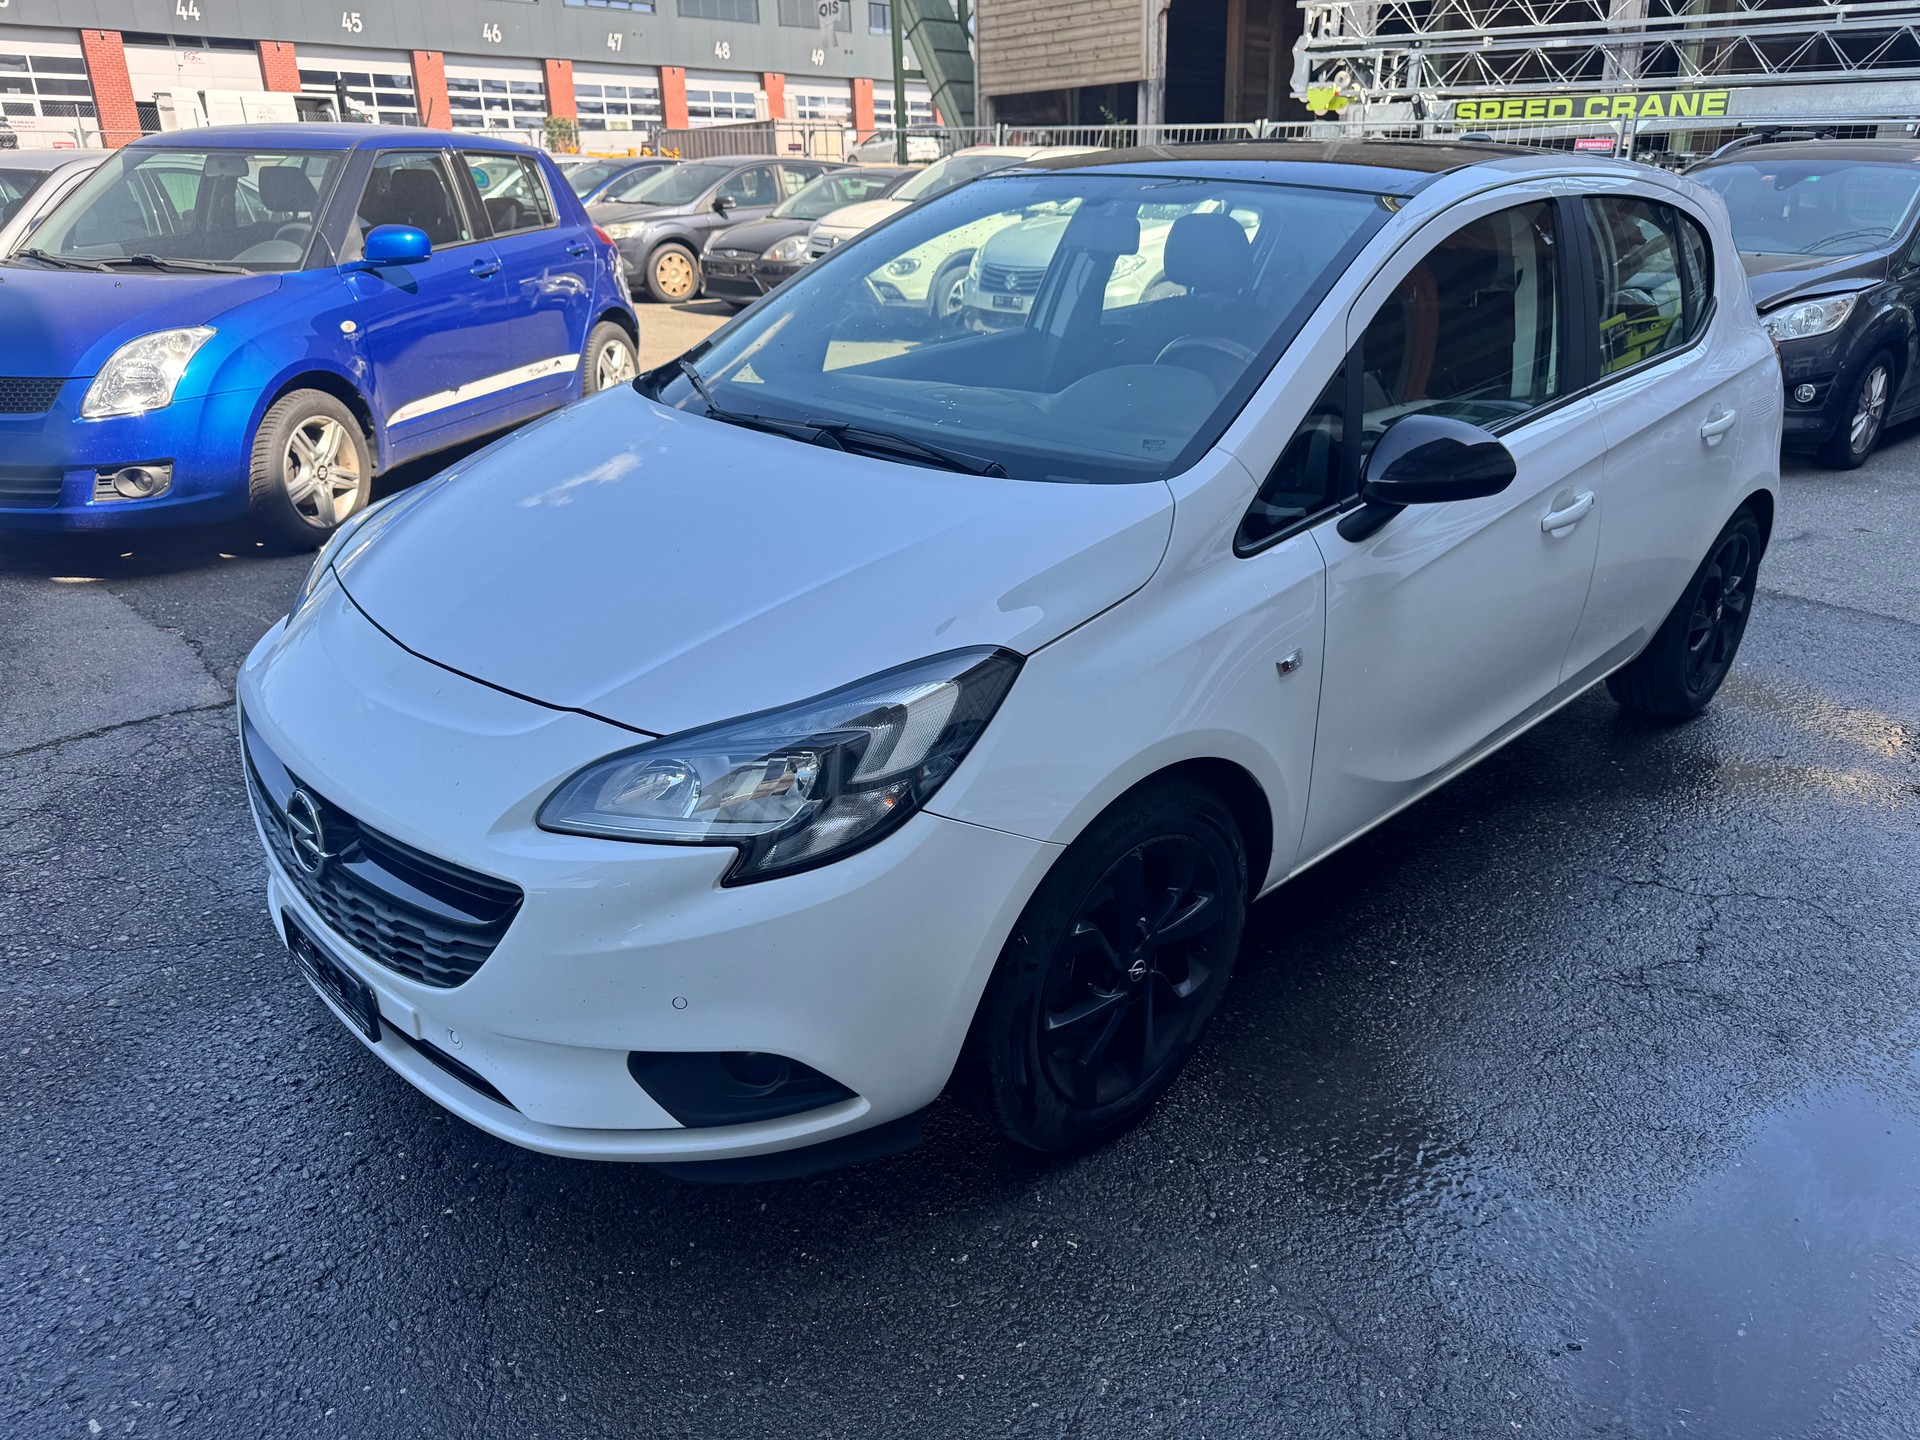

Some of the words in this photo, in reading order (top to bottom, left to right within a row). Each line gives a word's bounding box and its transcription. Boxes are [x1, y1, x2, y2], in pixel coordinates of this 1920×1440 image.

[176, 0, 200, 21] 44
[342, 12, 363, 33] 45
[483, 23, 502, 43] 46
[607, 33, 623, 51] 47
[715, 41, 731, 60] 48
[812, 49, 825, 66] 49
[1455, 98, 1574, 122] SPEED
[1584, 92, 1728, 119] CRANE
